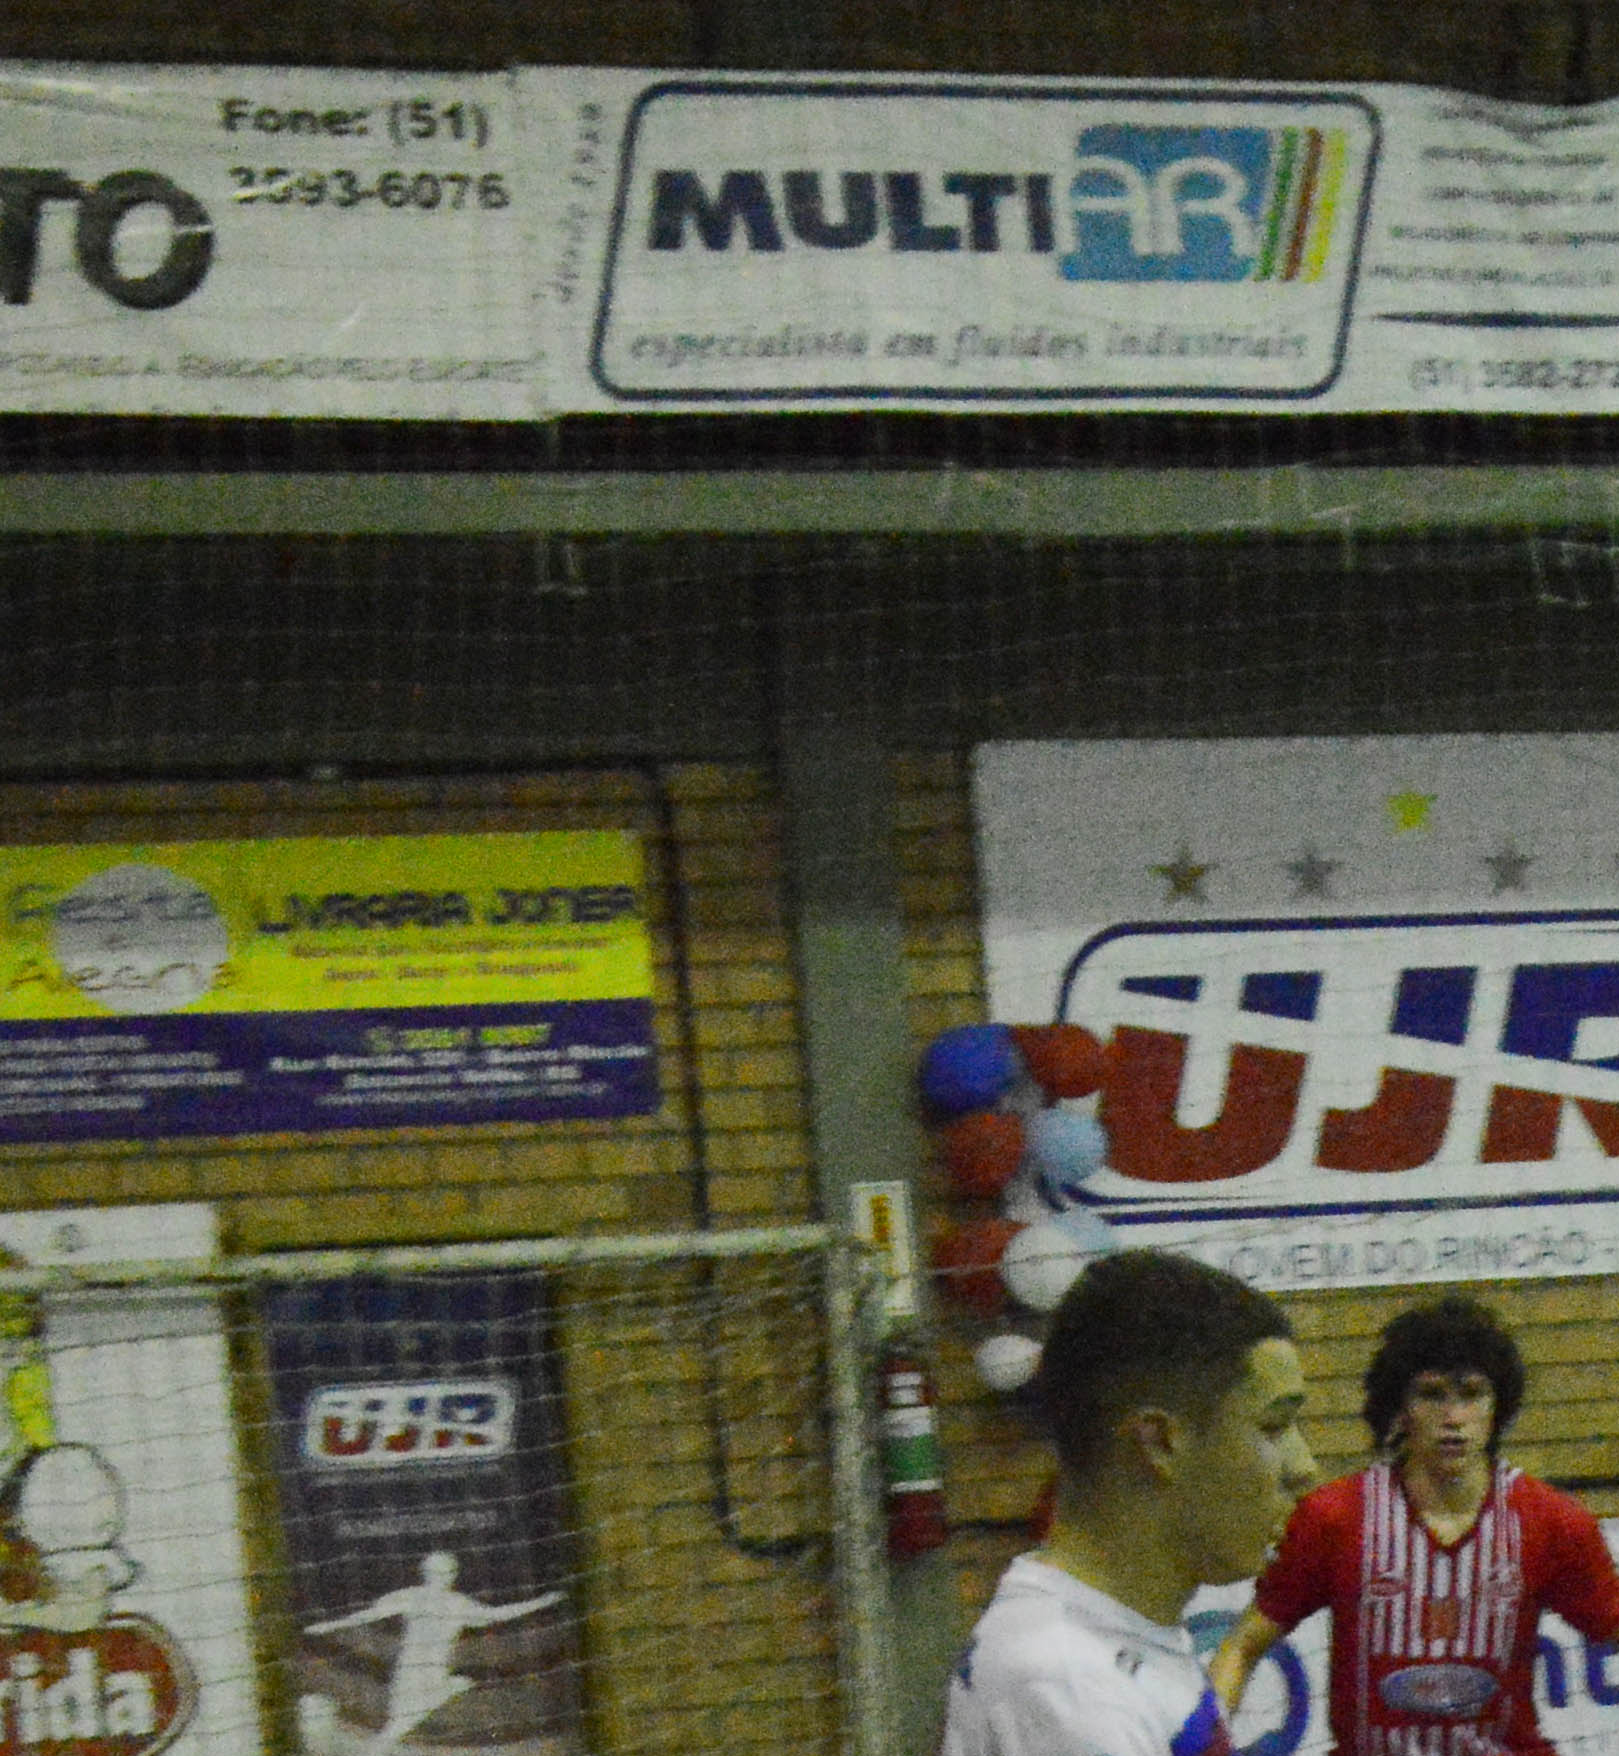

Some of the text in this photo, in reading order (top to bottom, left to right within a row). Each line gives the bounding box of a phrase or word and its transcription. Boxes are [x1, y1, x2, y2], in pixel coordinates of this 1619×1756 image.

[218, 96, 490, 148] Fone: (51)
[647, 168, 1056, 254] MULTI
[1224, 1237, 1353, 1287] OVEM
[0, 1645, 157, 1746] ida
